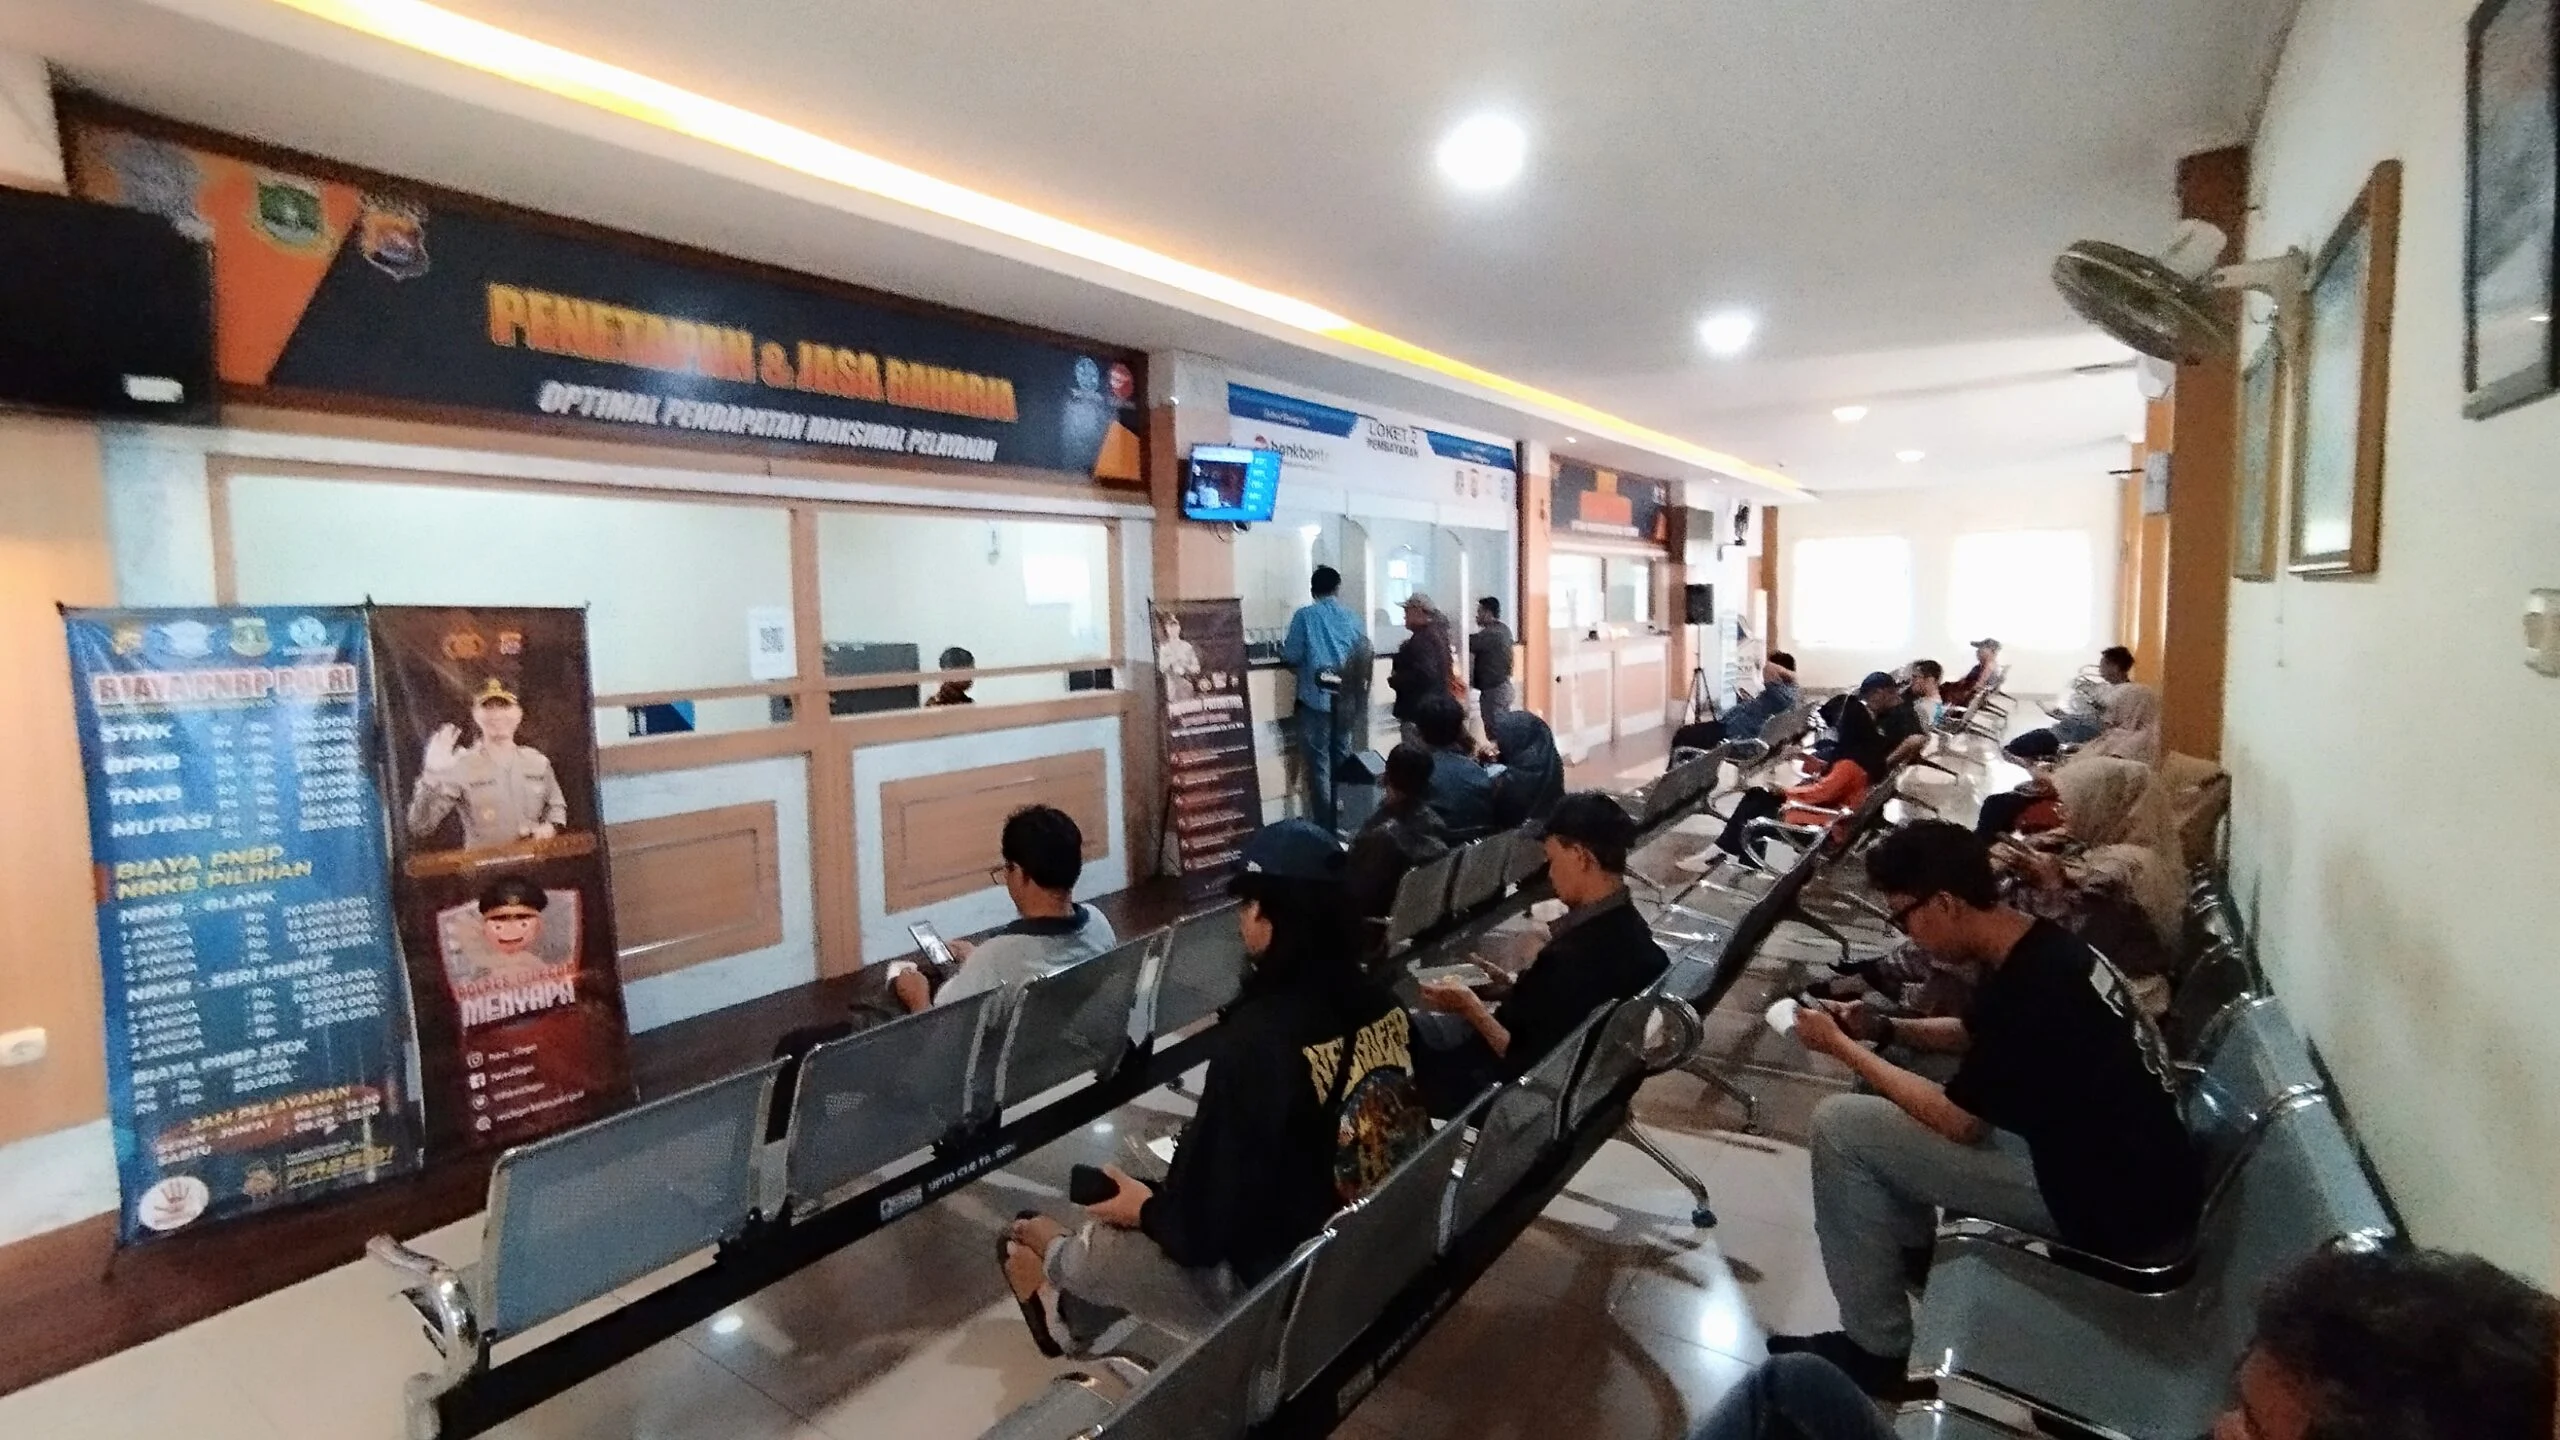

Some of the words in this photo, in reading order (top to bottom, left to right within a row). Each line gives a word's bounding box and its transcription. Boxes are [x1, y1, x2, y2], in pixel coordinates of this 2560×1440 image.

[488, 283, 756, 384] PENETAPAN
[759, 341, 795, 389] &
[797, 340, 884, 402] JASA
[886, 355, 1018, 423] RAHARJA
[537, 379, 660, 426] OPTIMAL
[660, 396, 807, 440] PENDAPATAN
[806, 414, 907, 452] MAKSIMAL
[904, 428, 998, 462] PELAYANAN
[1369, 423, 1409, 443] LOKET
[101, 723, 173, 743] STNK
[104, 754, 181, 775] BPKB
[106, 783, 182, 805] TNKB
[110, 813, 213, 838] MUTASI
[115, 855, 201, 880] BIAYA
[211, 845, 284, 868] PNBP
[117, 875, 199, 900] NRKB
[207, 860, 312, 887] PILIHAN
[118, 903, 184, 925] NRKB
[202, 891, 275, 912] BLANK
[132, 922, 190, 940] ANGKA
[135, 936, 193, 953] ANGKA
[136, 948, 196, 967] ANGKA
[126, 980, 192, 1003] NRKB
[208, 967, 259, 988] SERI
[263, 954, 334, 979] HURUF
[136, 1000, 197, 1019] ANGKA
[460, 980, 576, 1028] MENYAPA
[139, 1012, 201, 1031] ANGKA
[143, 1025, 202, 1045] ANGKA
[143, 1039, 205, 1058] ANGKA
[133, 1061, 195, 1085] BIAYA
[200, 1048, 258, 1070] PNBP
[259, 1038, 308, 1059] STCK
[238, 1085, 350, 1121] PELAYANAN
